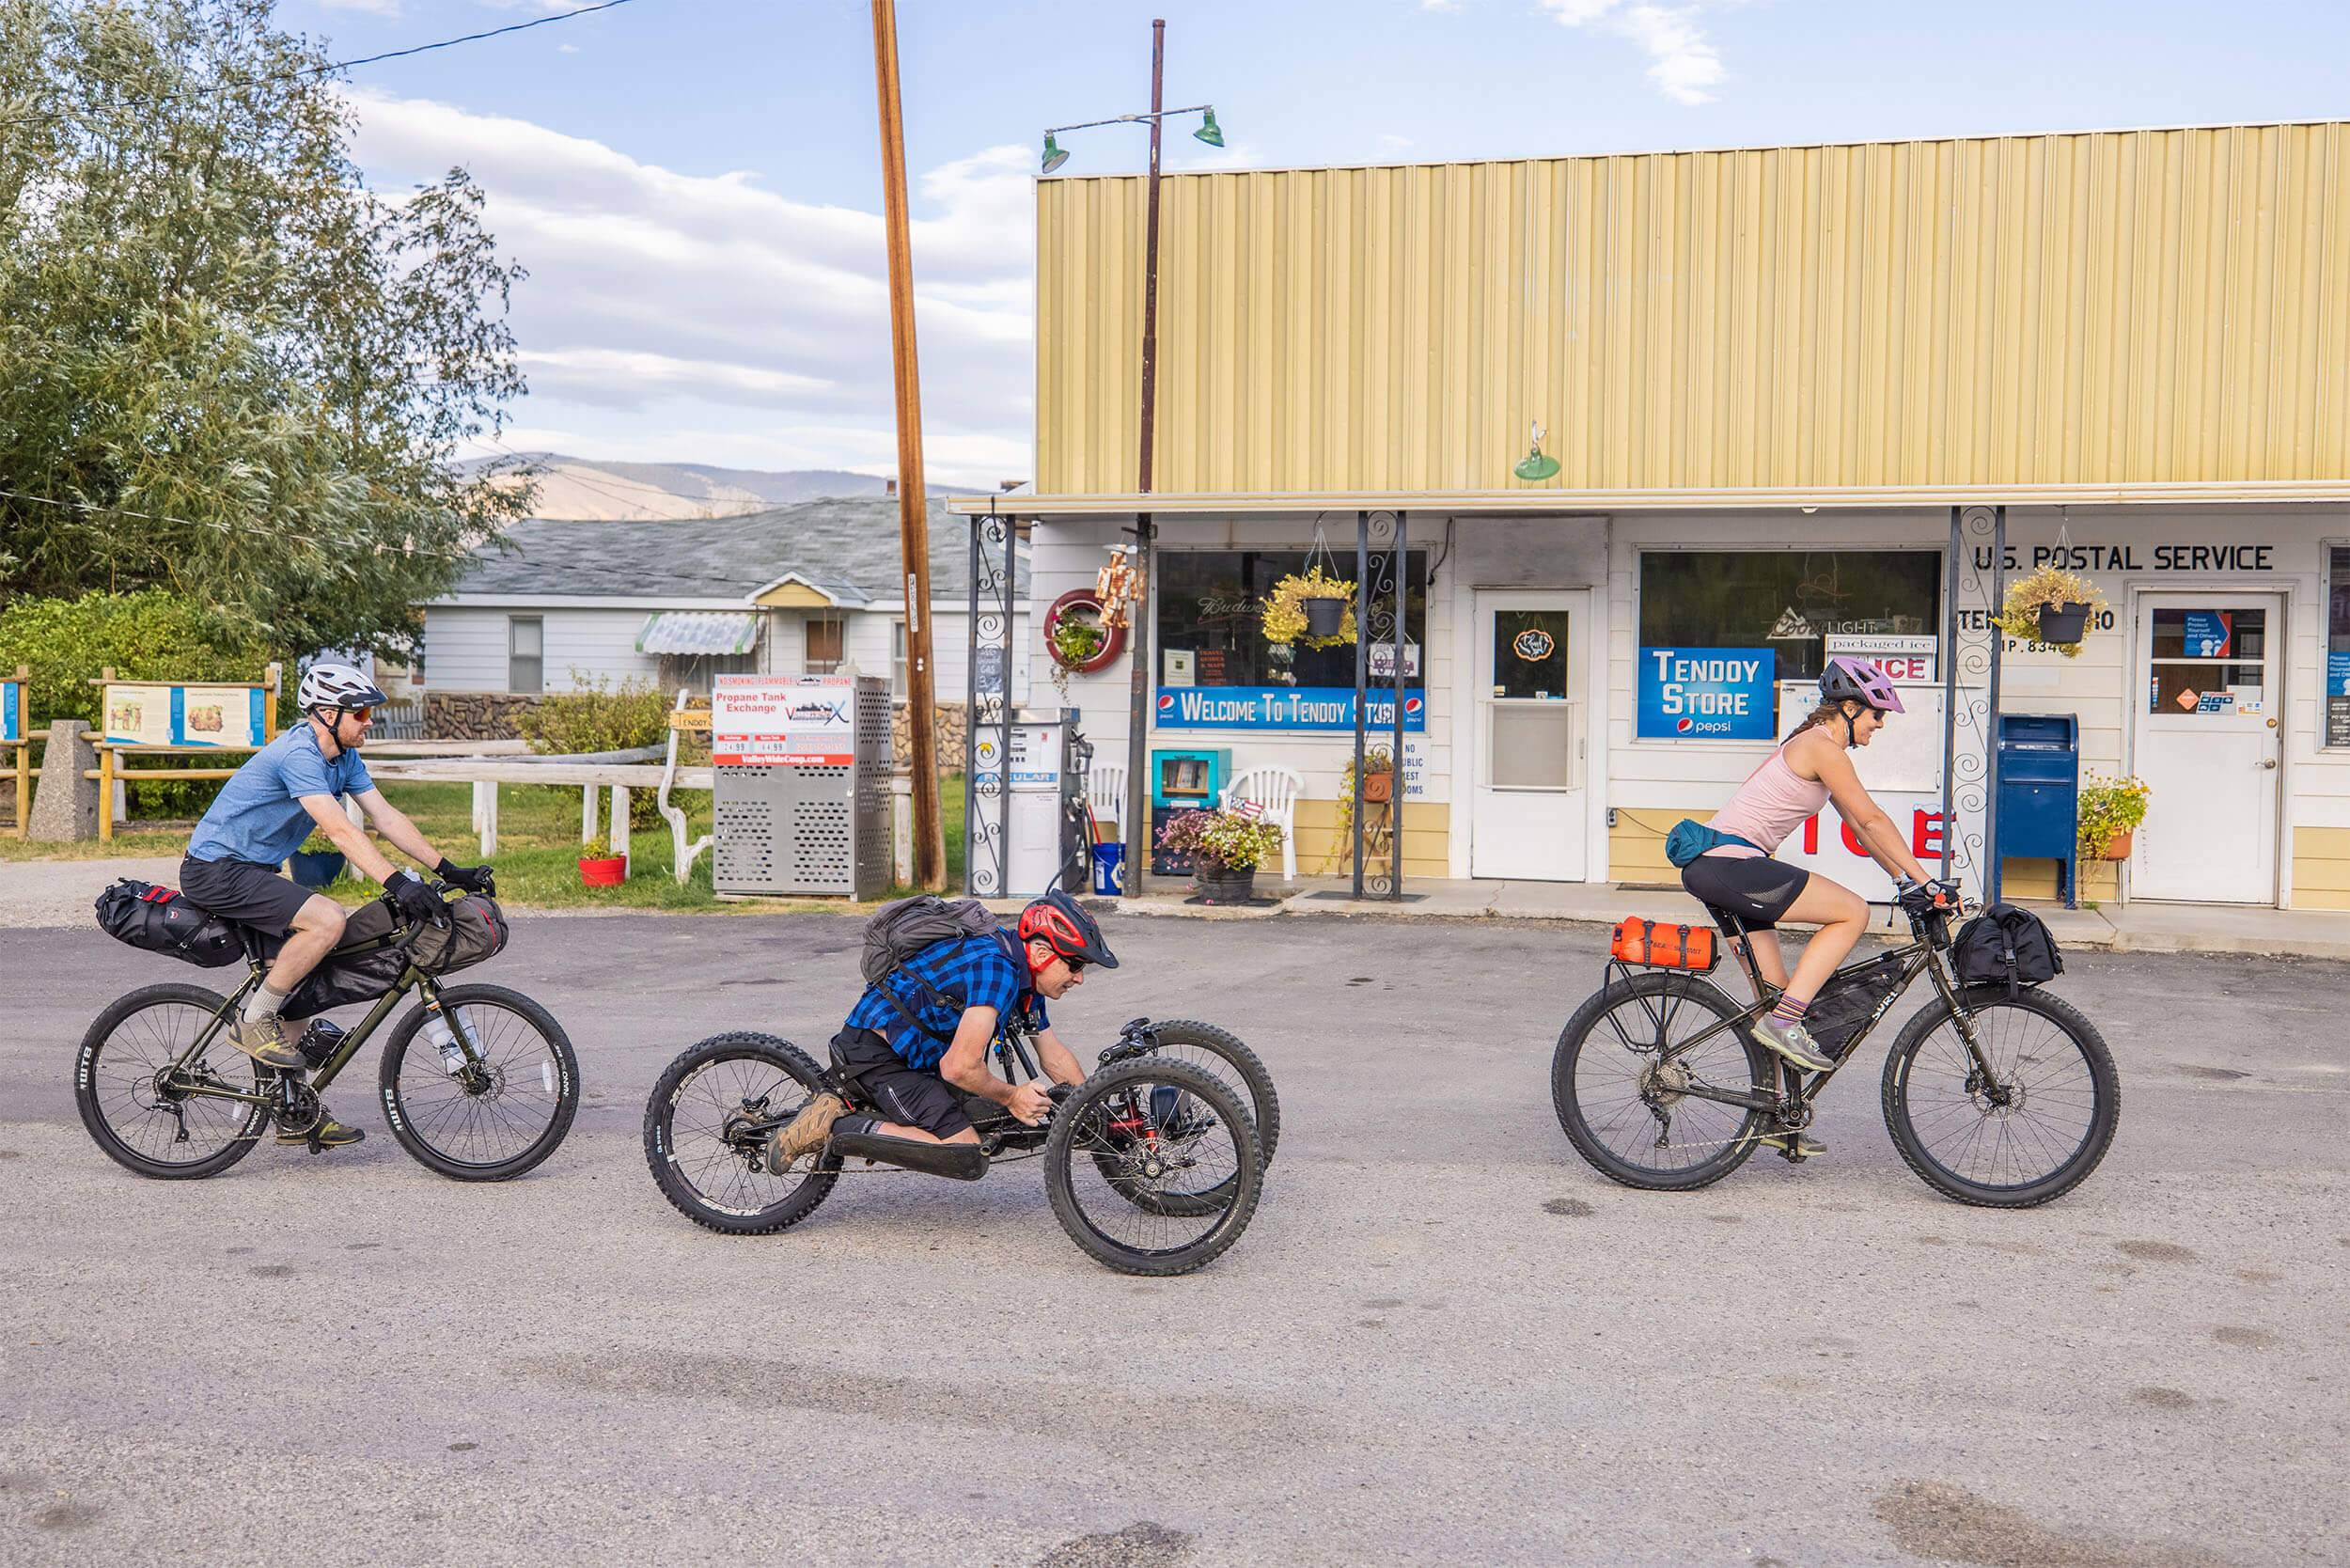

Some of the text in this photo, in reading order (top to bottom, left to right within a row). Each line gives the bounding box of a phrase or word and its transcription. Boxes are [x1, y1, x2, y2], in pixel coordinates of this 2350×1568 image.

[2033, 546, 2143, 571] POSTAL
[2154, 545, 2273, 571] SERVICE
[1832, 640, 1931, 651] packaged ice
[1653, 651, 1761, 683] TENDOY
[716, 692, 786, 702] Propane Tank
[1662, 683, 1749, 715] STORE
[727, 705, 776, 714] Exchange
[1181, 692, 1257, 722] WELCOME
[1262, 693, 1283, 722] TO
[1289, 693, 1347, 724] TENDOY
[1695, 720, 1731, 733] pepsi
